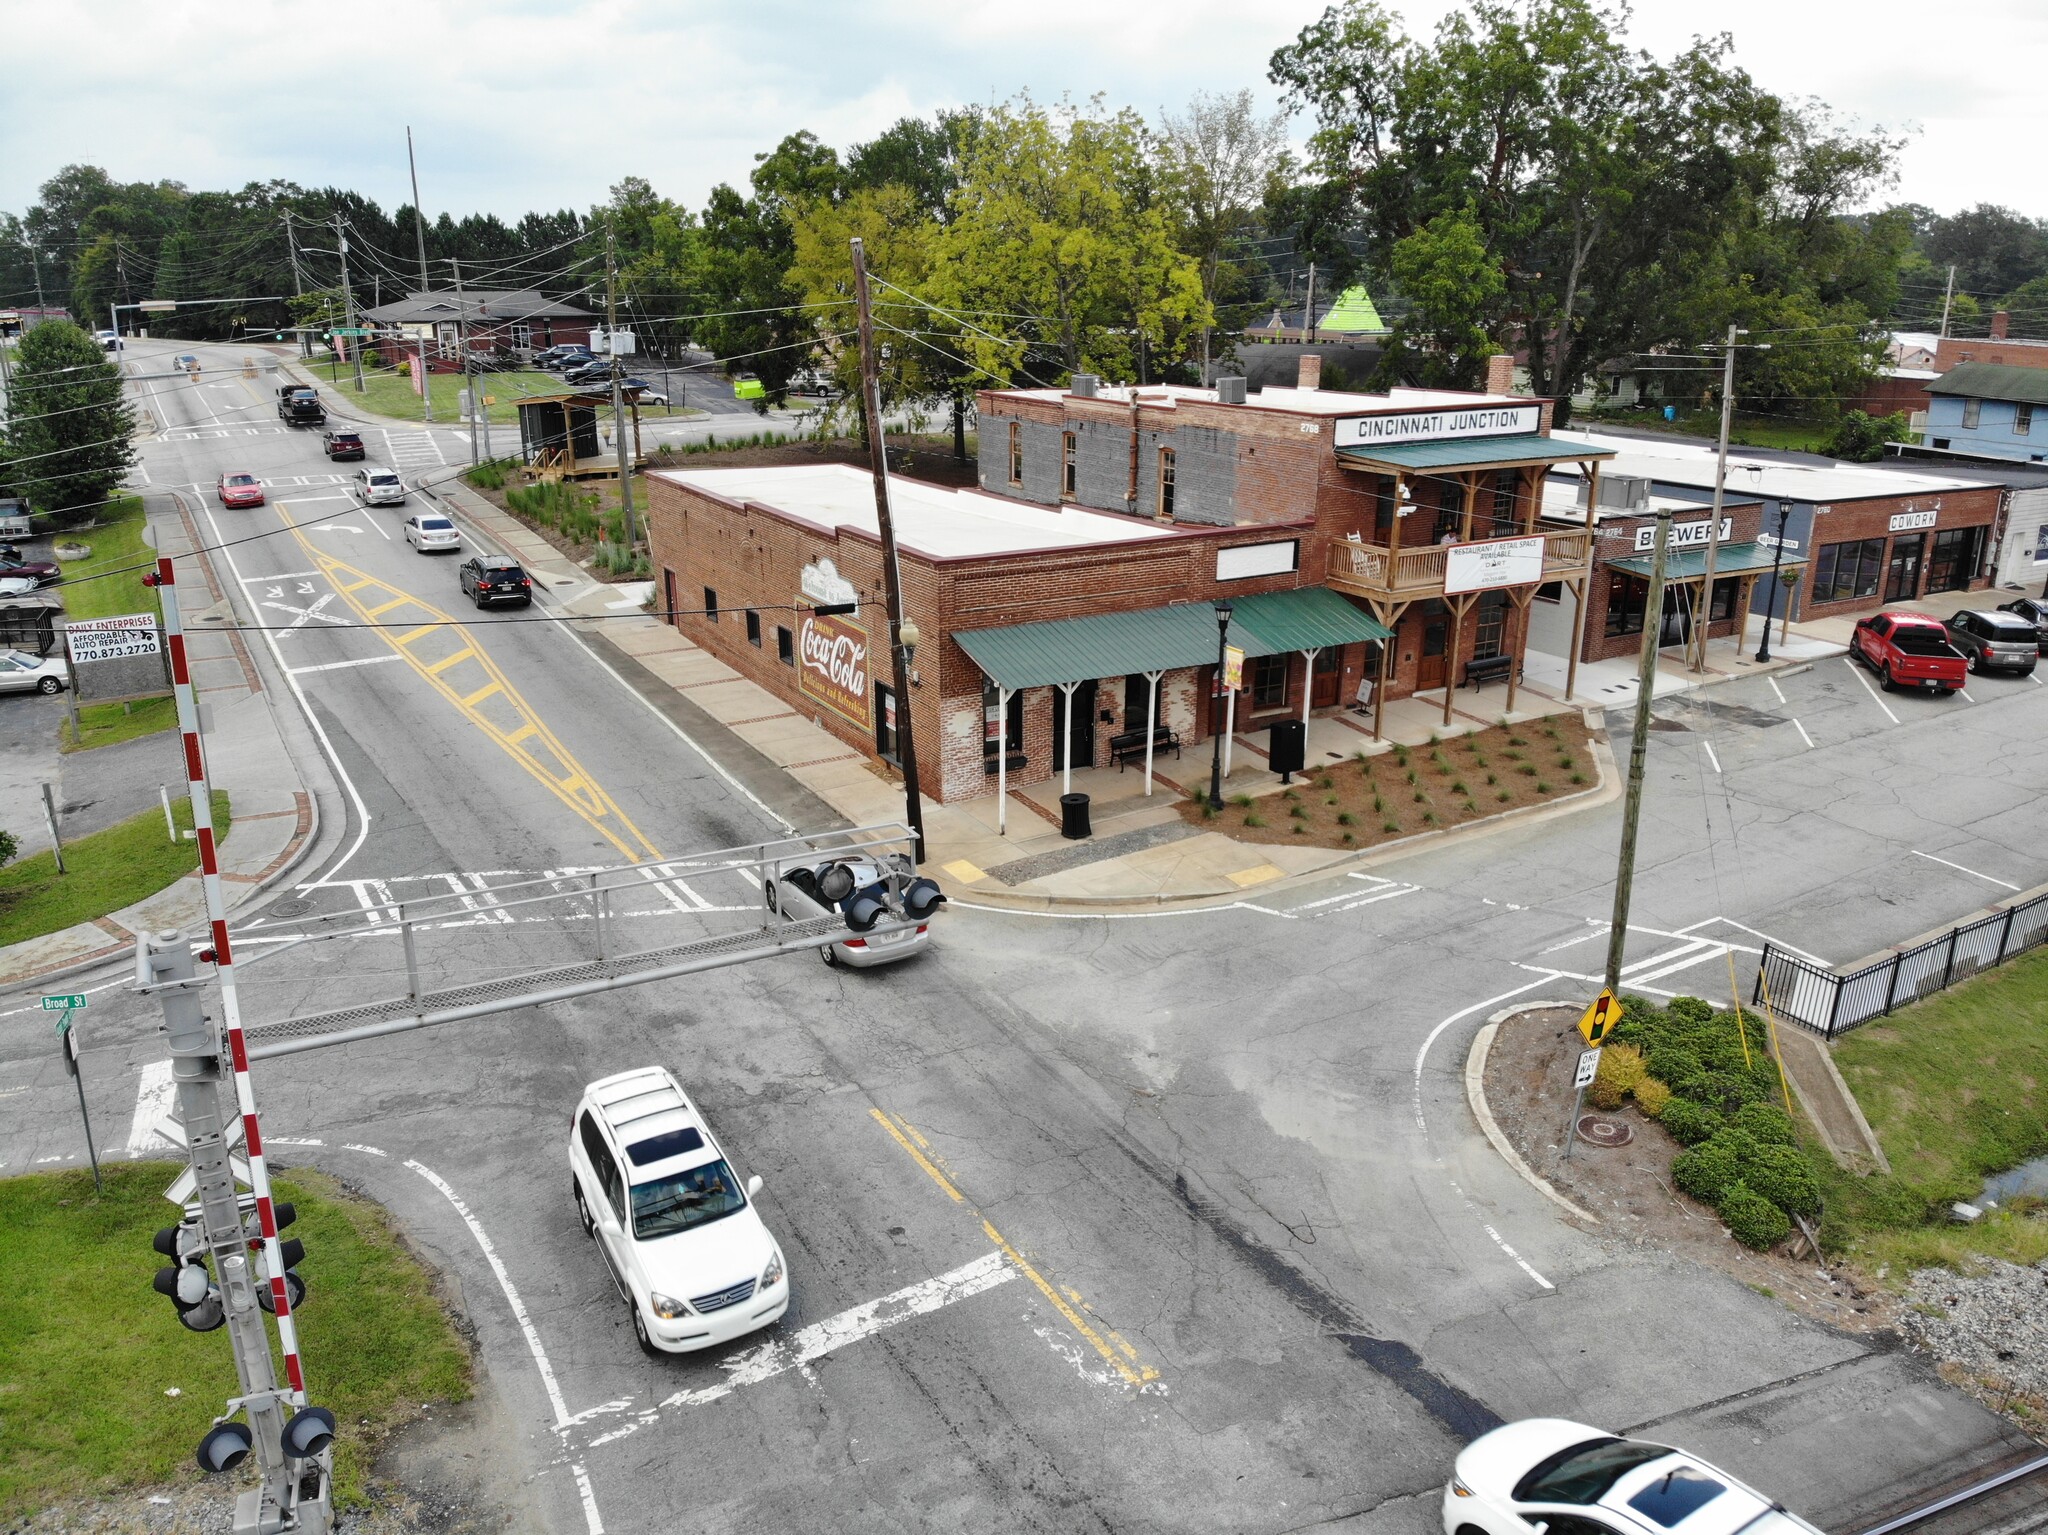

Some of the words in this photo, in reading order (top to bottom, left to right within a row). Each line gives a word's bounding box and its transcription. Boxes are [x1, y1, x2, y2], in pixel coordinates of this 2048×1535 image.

[1300, 422, 1320, 434] 2768
[1359, 415, 1444, 438] CINCINNATI
[1449, 410, 1519, 431] JUNCTION
[1891, 512, 1935, 529] COWORK
[1640, 523, 1727, 546] BEWERY
[1454, 545, 1493, 555] RESTAURANT
[1499, 541, 1518, 550] RETAIL
[1519, 539, 1537, 547] SPACE
[1774, 539, 1797, 547] GRDEN
[1480, 550, 1511, 560] AVAILABLE
[68, 624, 93, 634] DAILY
[96, 616, 153, 630] ENTERPRISES
[815, 622, 834, 637] DRINK
[73, 630, 127, 643] AFFORDABLE
[74, 640, 96, 650] AUTO
[99, 637, 128, 647] REPAIR
[75, 643, 156, 661] 770.873.2720
[801, 618, 867, 696] Coca-Cola
[44, 997, 69, 1009] Broad
[74, 995, 84, 1007] St
[1582, 1052, 1598, 1064] ONE
[1579, 1063, 1596, 1074] WAY
